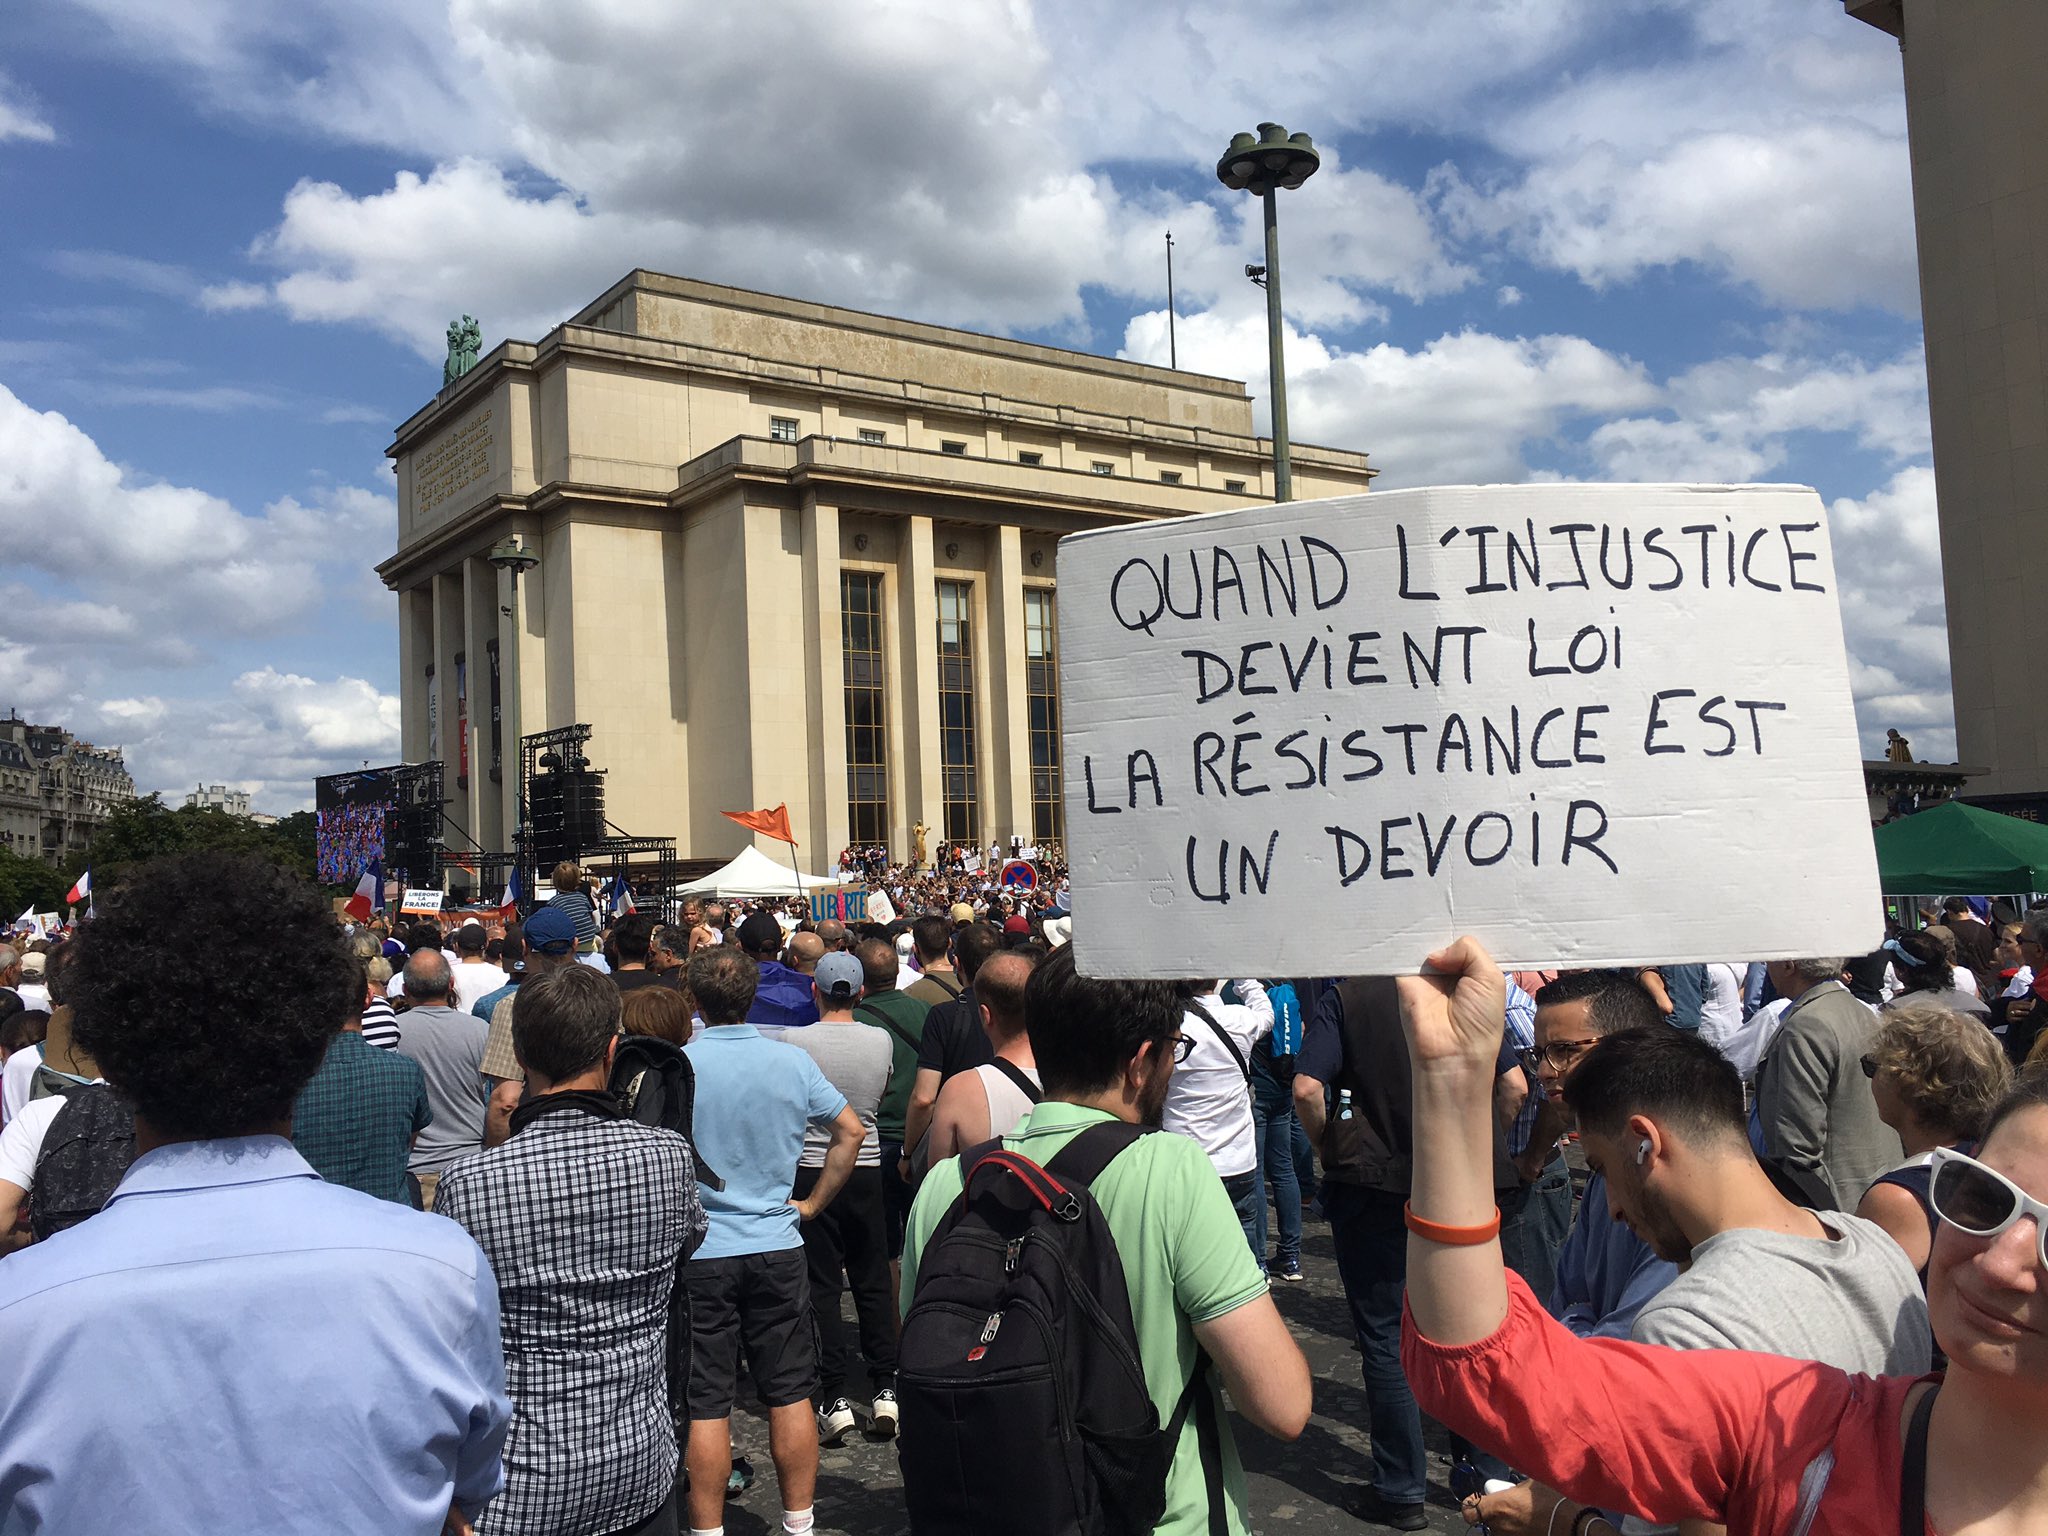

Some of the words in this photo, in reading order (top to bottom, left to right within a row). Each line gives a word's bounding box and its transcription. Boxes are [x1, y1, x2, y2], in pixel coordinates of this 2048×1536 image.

[1110, 535, 1349, 638] QUAND
[1083, 749, 1164, 815] LA
[1644, 689, 1787, 757] EST
[1186, 829, 1279, 905] UN
